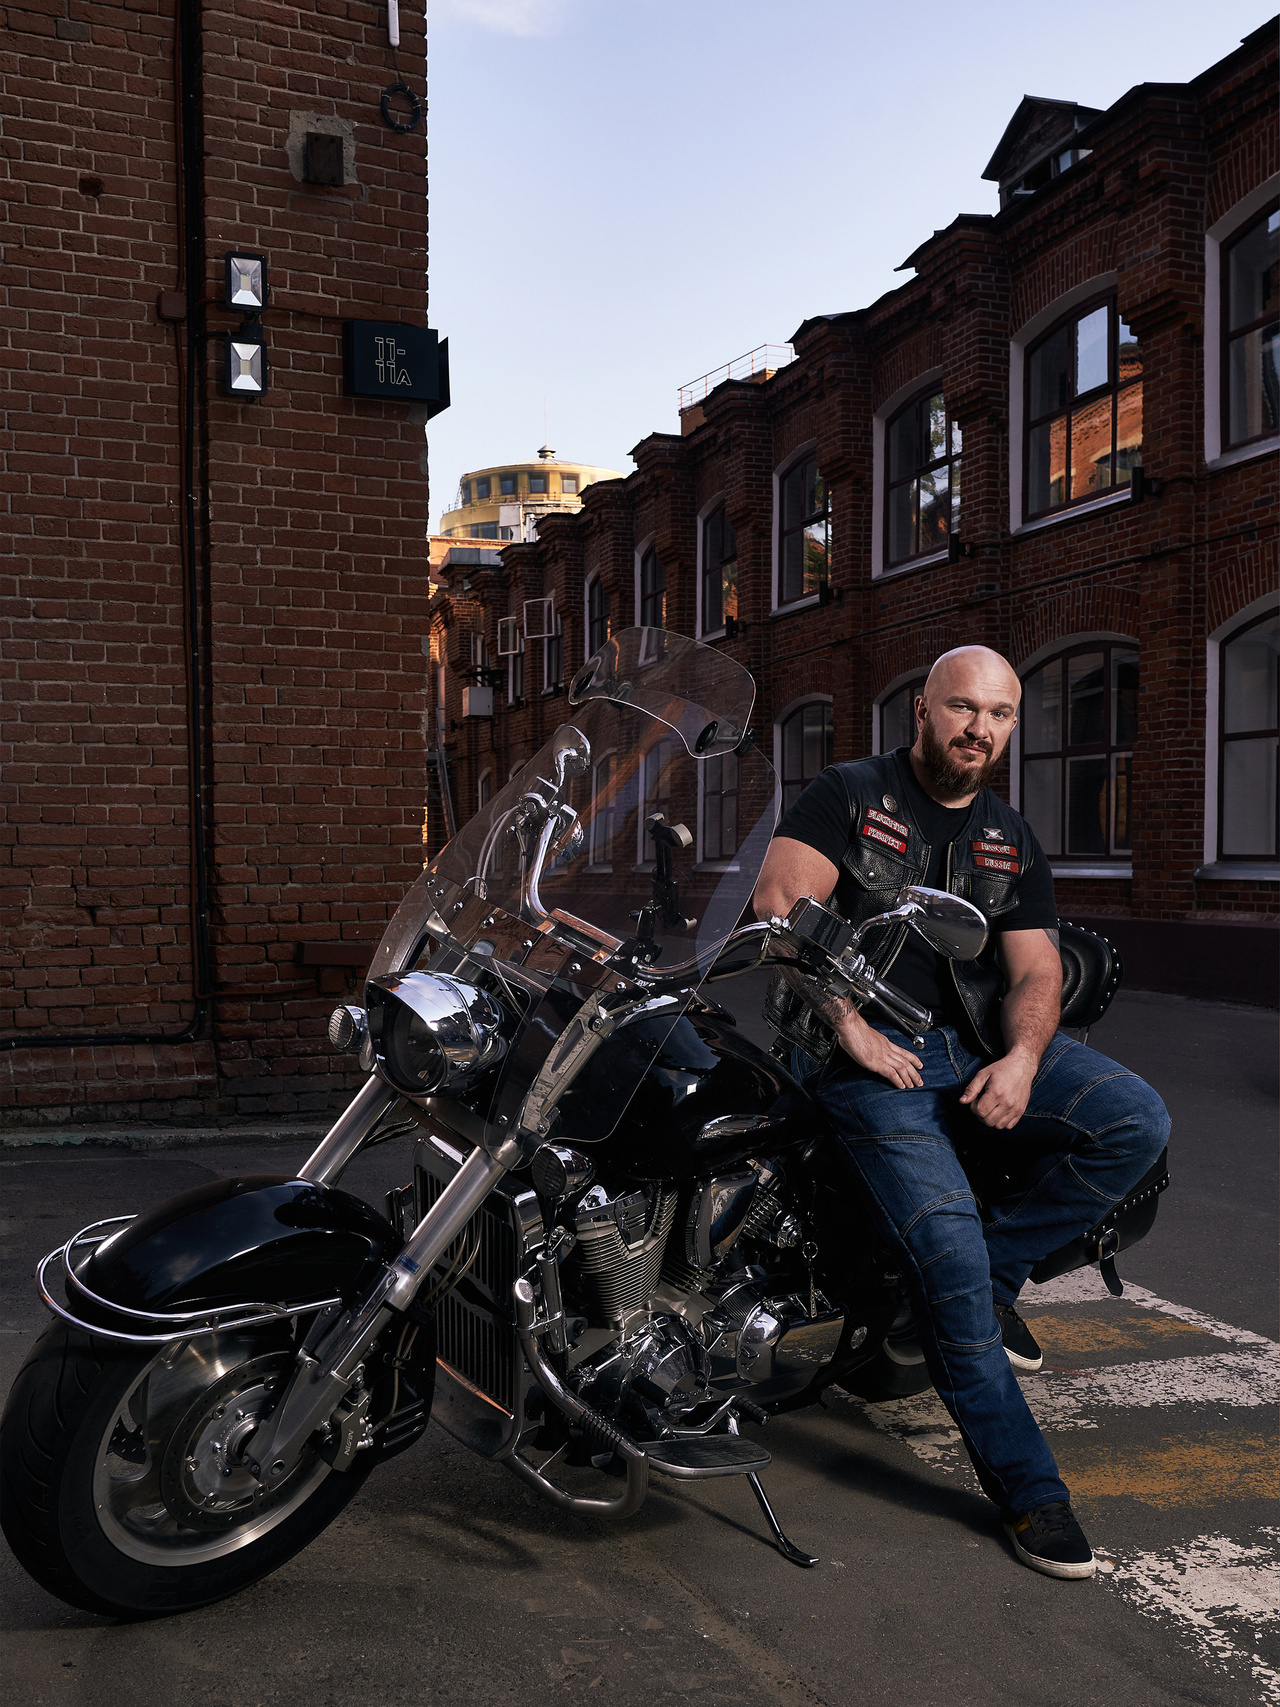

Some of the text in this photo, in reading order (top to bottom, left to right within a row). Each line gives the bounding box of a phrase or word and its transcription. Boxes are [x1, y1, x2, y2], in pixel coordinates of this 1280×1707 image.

[867, 826, 902, 849] PROSPECT
[981, 842, 1011, 854] MOSCOW
[984, 857, 1012, 870] RUSSIA
